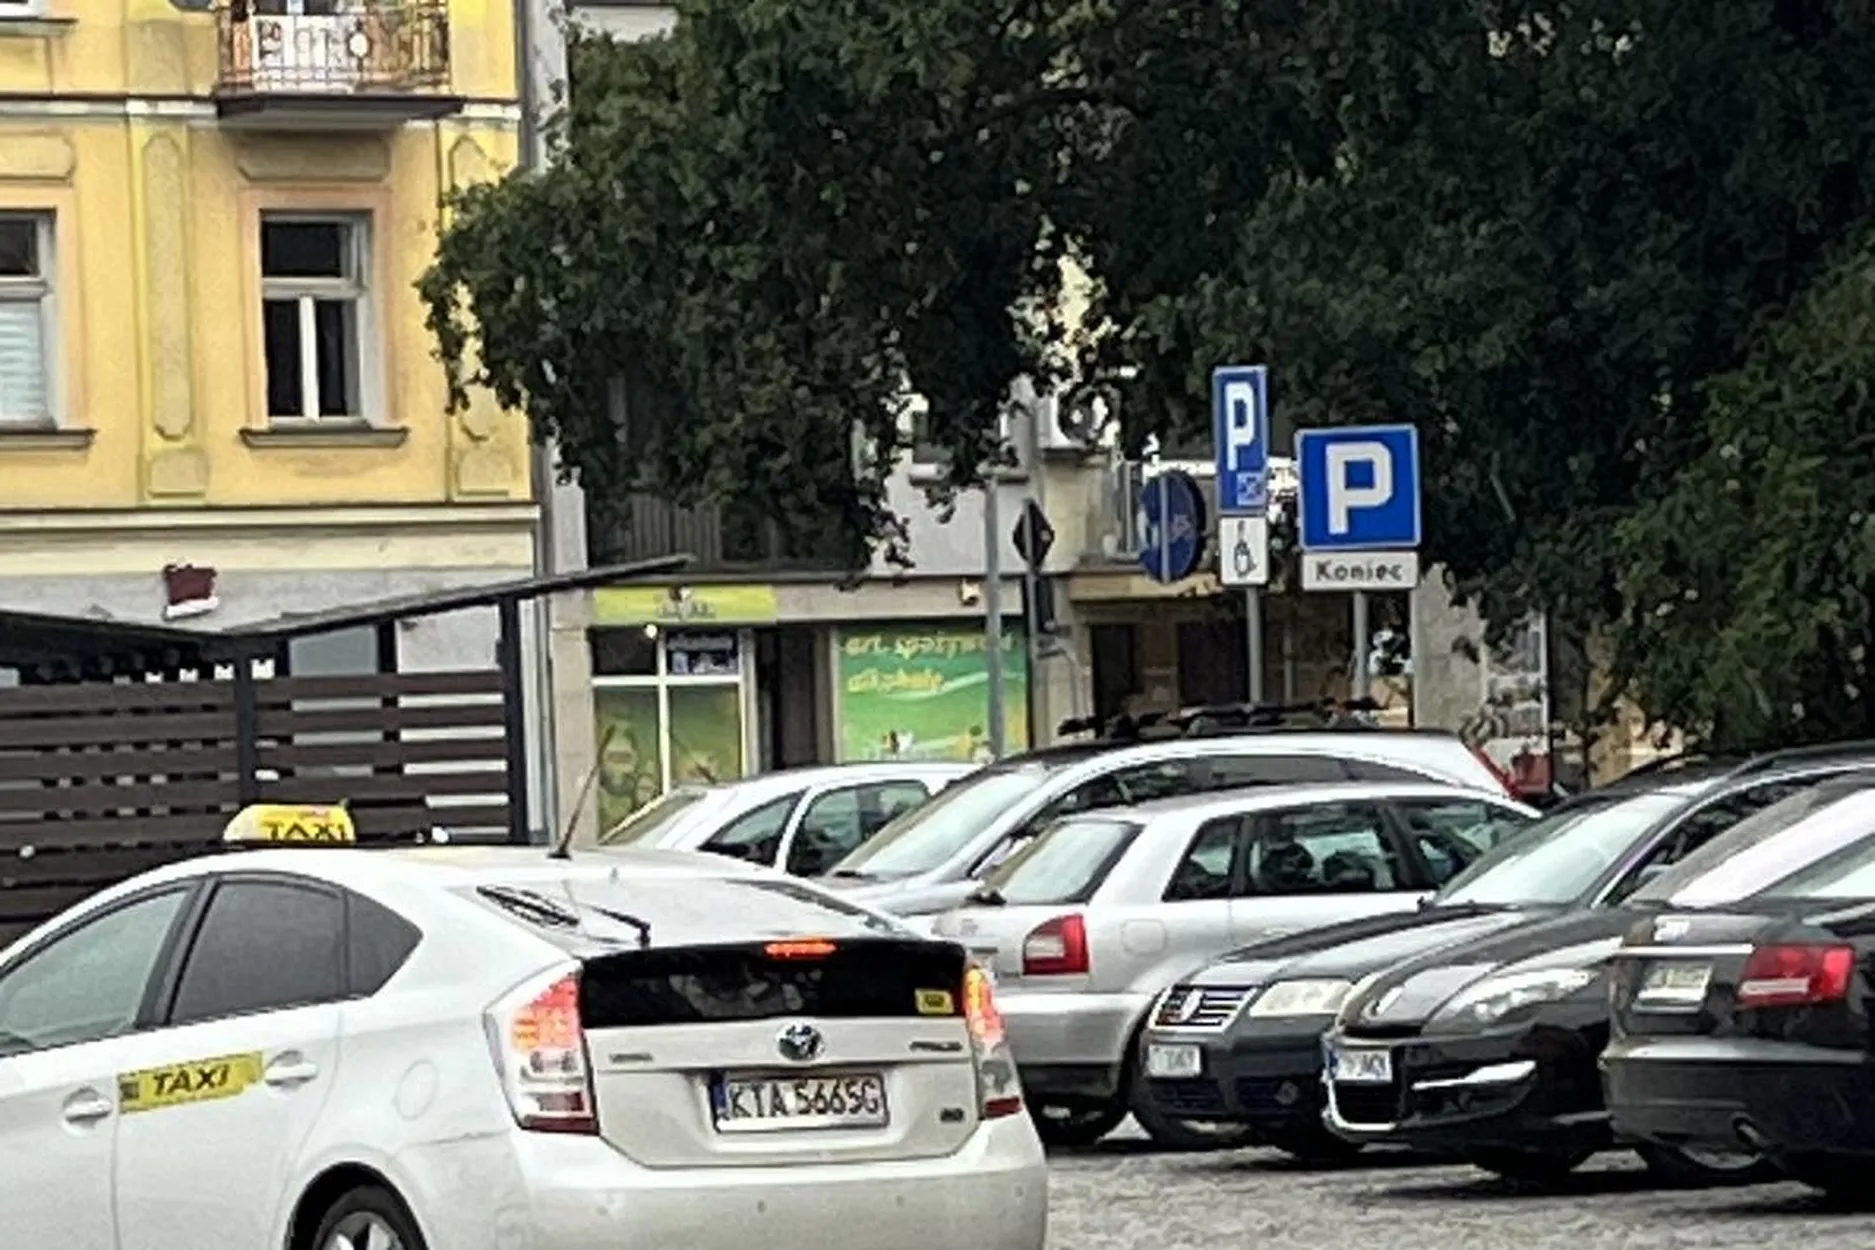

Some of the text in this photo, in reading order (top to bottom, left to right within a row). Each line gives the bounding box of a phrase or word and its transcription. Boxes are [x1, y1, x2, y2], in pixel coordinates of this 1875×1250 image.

[1225, 381, 1255, 471] P
[1325, 441, 1393, 535] P
[1315, 560, 1403, 582] Koniec
[261, 820, 347, 841] TAXI
[153, 1063, 230, 1096] TAXI
[731, 1078, 880, 1118] KTA 5665G
